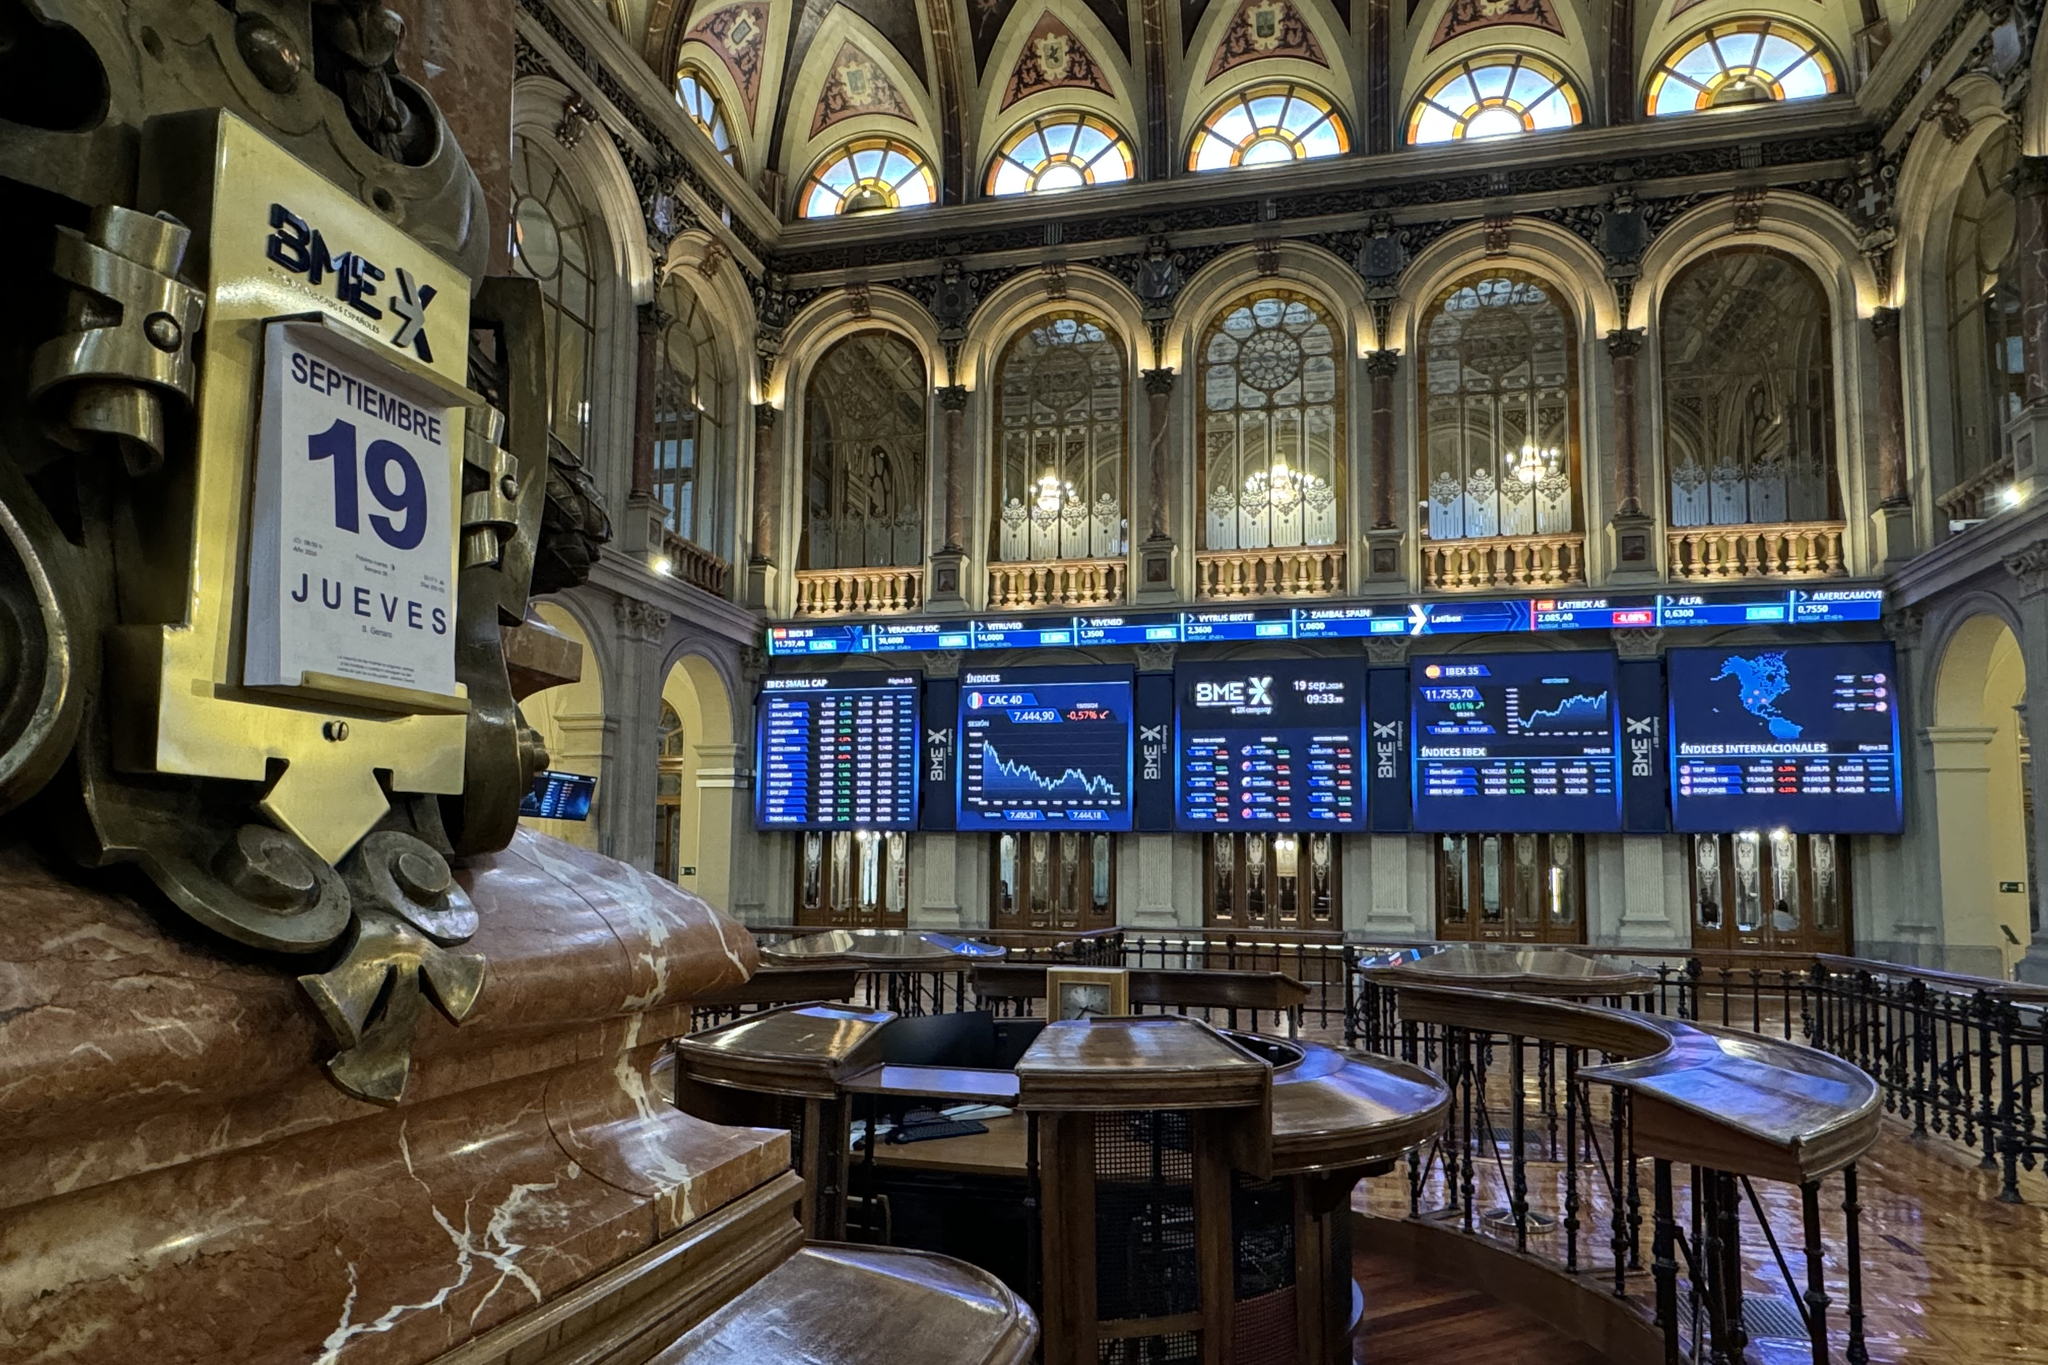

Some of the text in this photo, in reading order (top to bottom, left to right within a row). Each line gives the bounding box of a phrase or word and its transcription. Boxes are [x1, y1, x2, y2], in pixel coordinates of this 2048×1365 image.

[343, 309, 380, 334] ESPAÑOLES
[291, 352, 442, 447] SEPTIEMBRE
[308, 418, 428, 551] 19
[1812, 590, 1883, 600] AMERICAMOVI
[291, 573, 447, 635] JUEVES
[1557, 601, 1593, 609] LATIBEX
[1679, 596, 1704, 605] ALFA
[1311, 609, 1371, 619] ZAMBAL SPAIN
[1664, 609, 1694, 618] 0,6300
[1798, 604, 1829, 614] 0,7550
[1090, 618, 1124, 627] VIVENIO
[1198, 614, 1229, 623] VYTRUS
[1431, 614, 1462, 623] Latibex
[887, 624, 940, 634] VERACRUZ SOC
[987, 621, 1023, 630] VITRUVIO
[788, 629, 804, 638] IBEX
[1445, 667, 1479, 676] IBEX 35
[966, 673, 1000, 684] ÍNDICES
[766, 679, 829, 689] IBEX SMALL CAP
[1293, 680, 1307, 691] 19
[1425, 689, 1474, 700] 11.755,70
[988, 695, 1023, 705] CAC 40
[1449, 702, 1474, 710] 0,61%
[1013, 711, 1055, 722] 7.444,90
[1066, 713, 1097, 721] -0,57%
[967, 719, 990, 727] SESIÓN
[1420, 746, 1487, 757] ÍNDICES IBEX
[1680, 743, 1828, 755] ÍNDICES INTERNACIONALES
